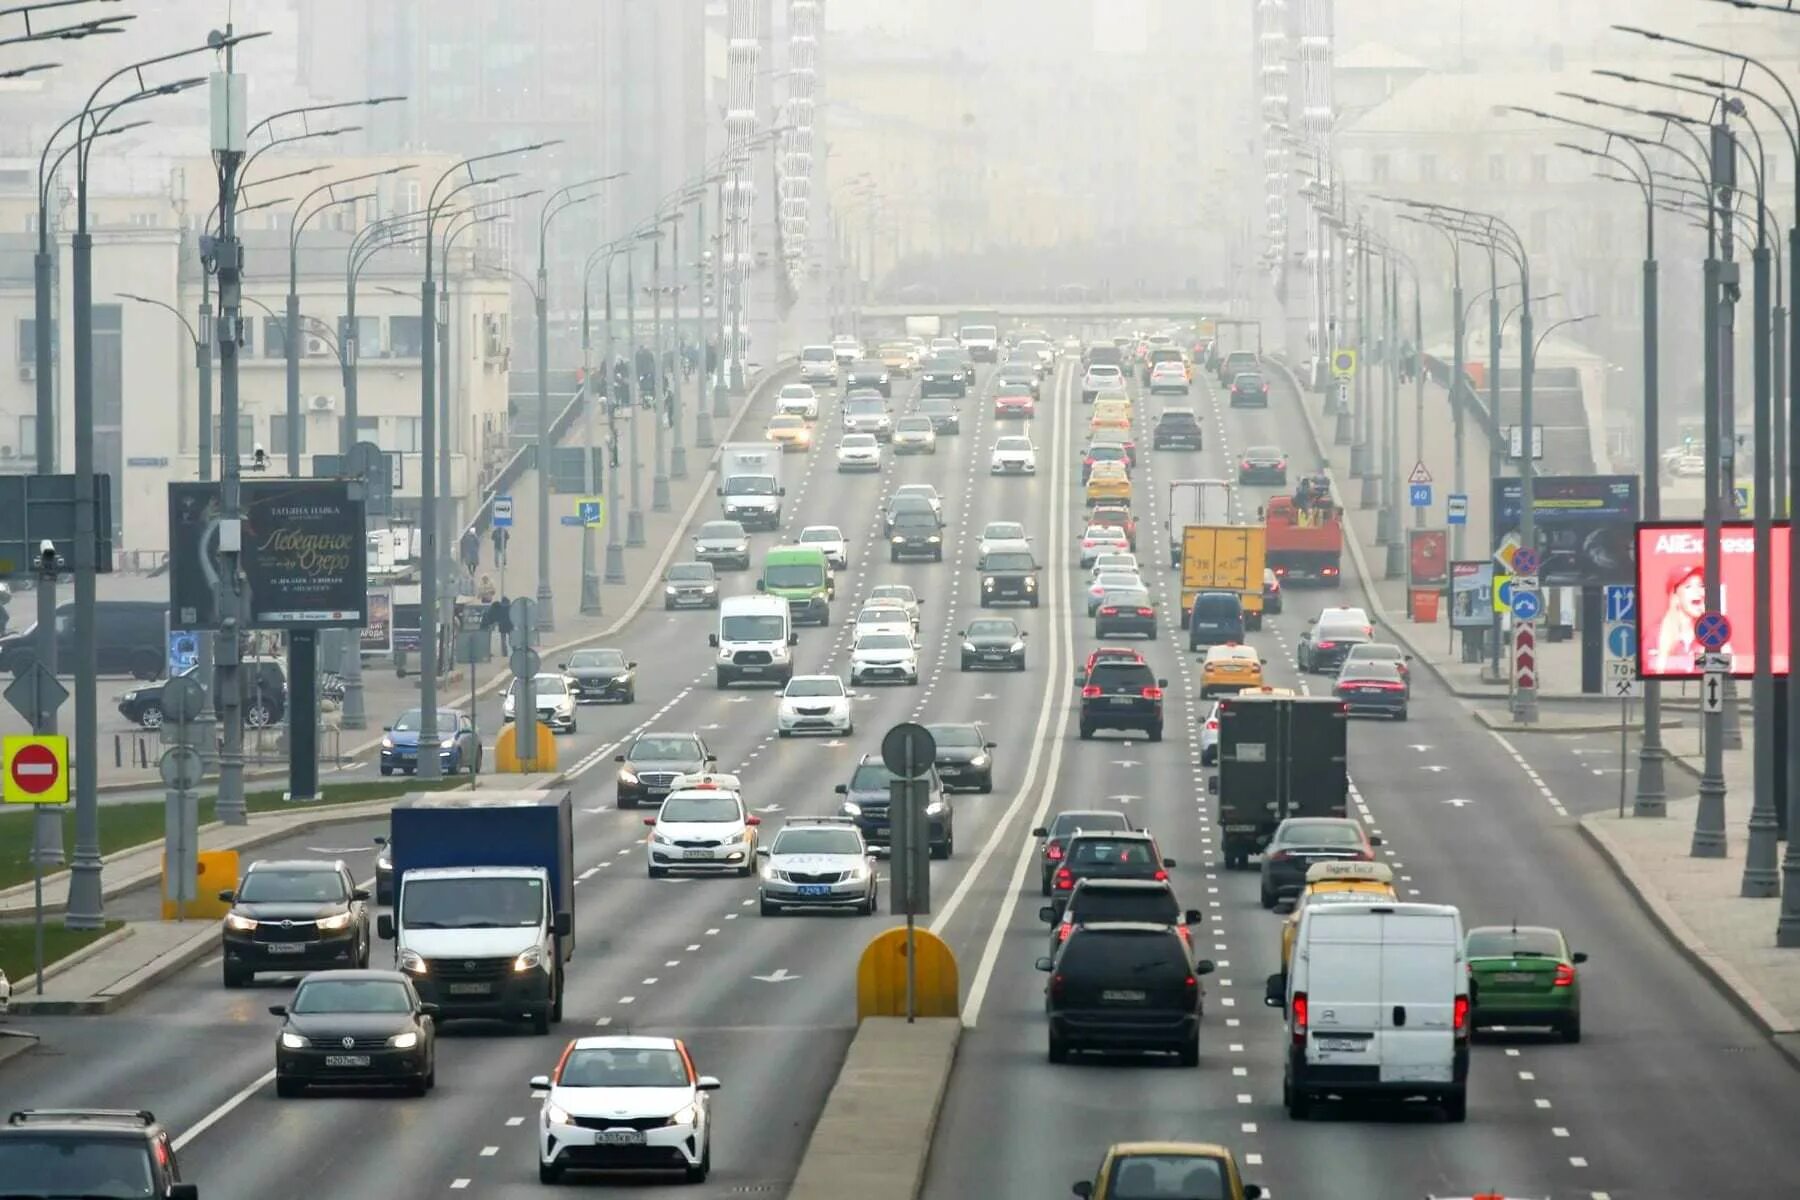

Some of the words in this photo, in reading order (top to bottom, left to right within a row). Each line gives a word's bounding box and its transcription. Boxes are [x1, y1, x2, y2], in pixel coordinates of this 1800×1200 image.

[1414, 491, 1428, 500] 40
[258, 529, 353, 551] Лебединое
[298, 549, 349, 576] Озеро
[1613, 664, 1629, 675] 70
